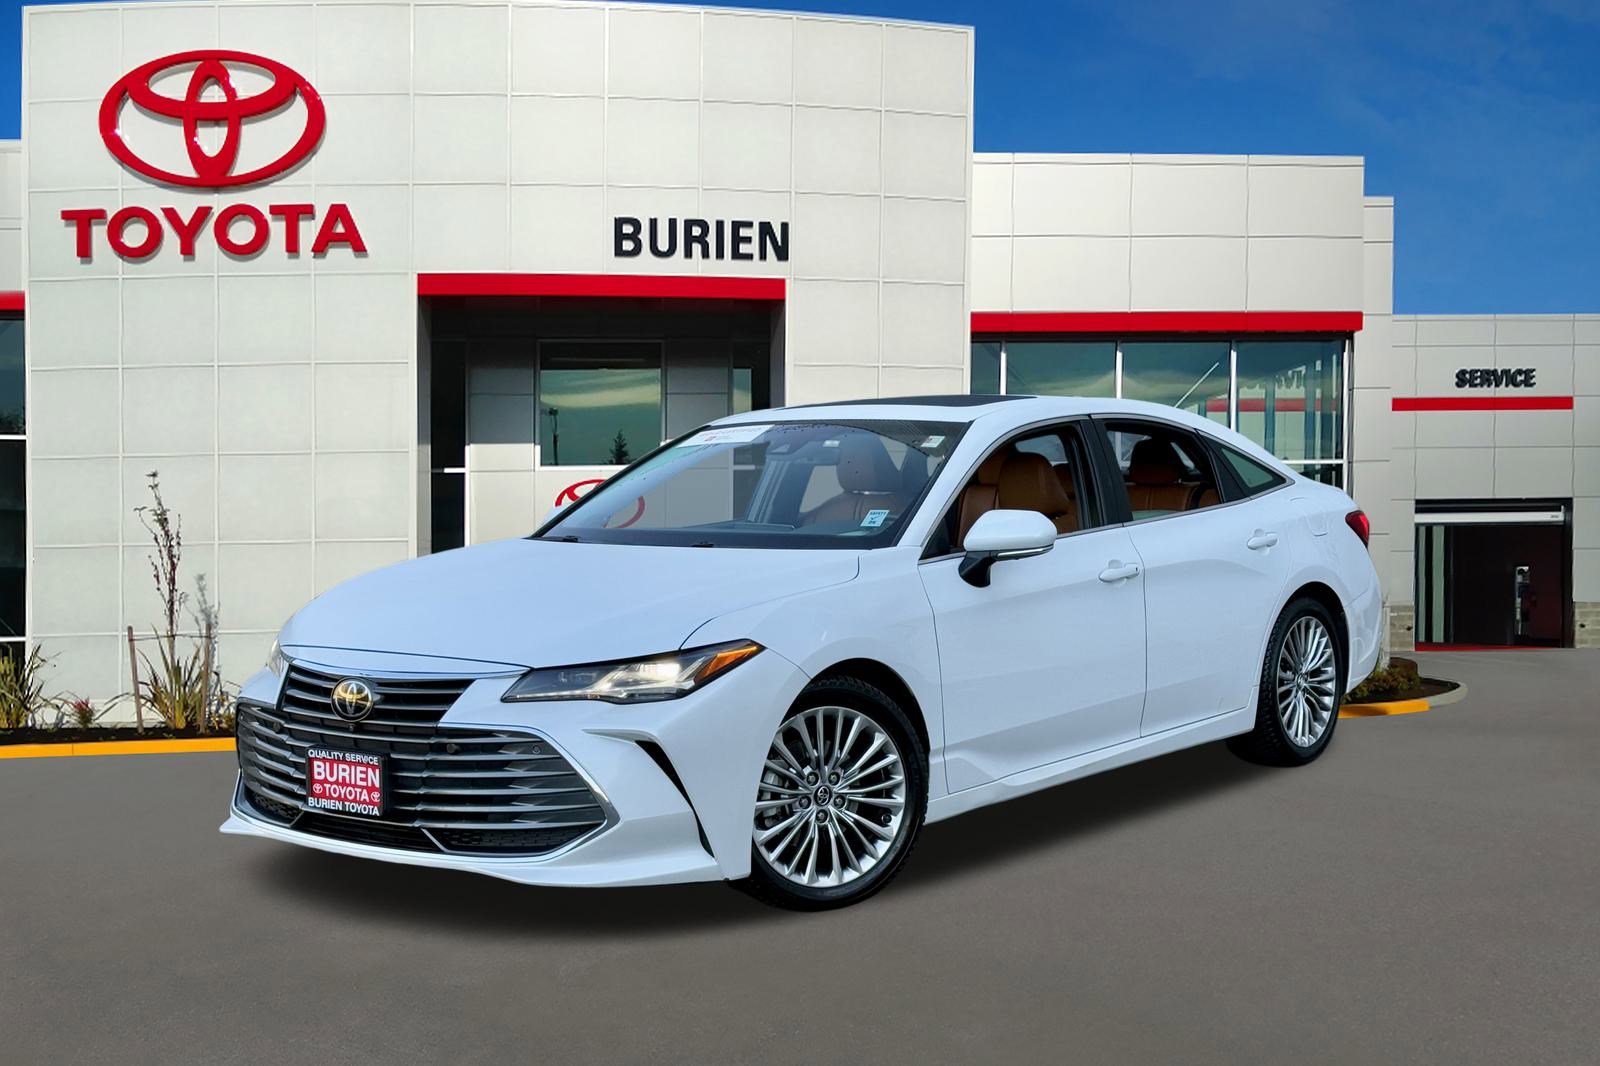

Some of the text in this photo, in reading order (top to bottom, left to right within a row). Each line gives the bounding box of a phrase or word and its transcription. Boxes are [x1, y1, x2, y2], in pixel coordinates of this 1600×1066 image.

[60, 203, 368, 260] TOYOTA
[614, 216, 790, 262] BURIEN
[1455, 367, 1536, 389] SERVICE
[307, 749, 344, 760] QUALITY
[313, 760, 380, 788] BURIEN
[323, 783, 370, 803] TOYOTA
[308, 797, 380, 816] BURIEN TOYOTA
